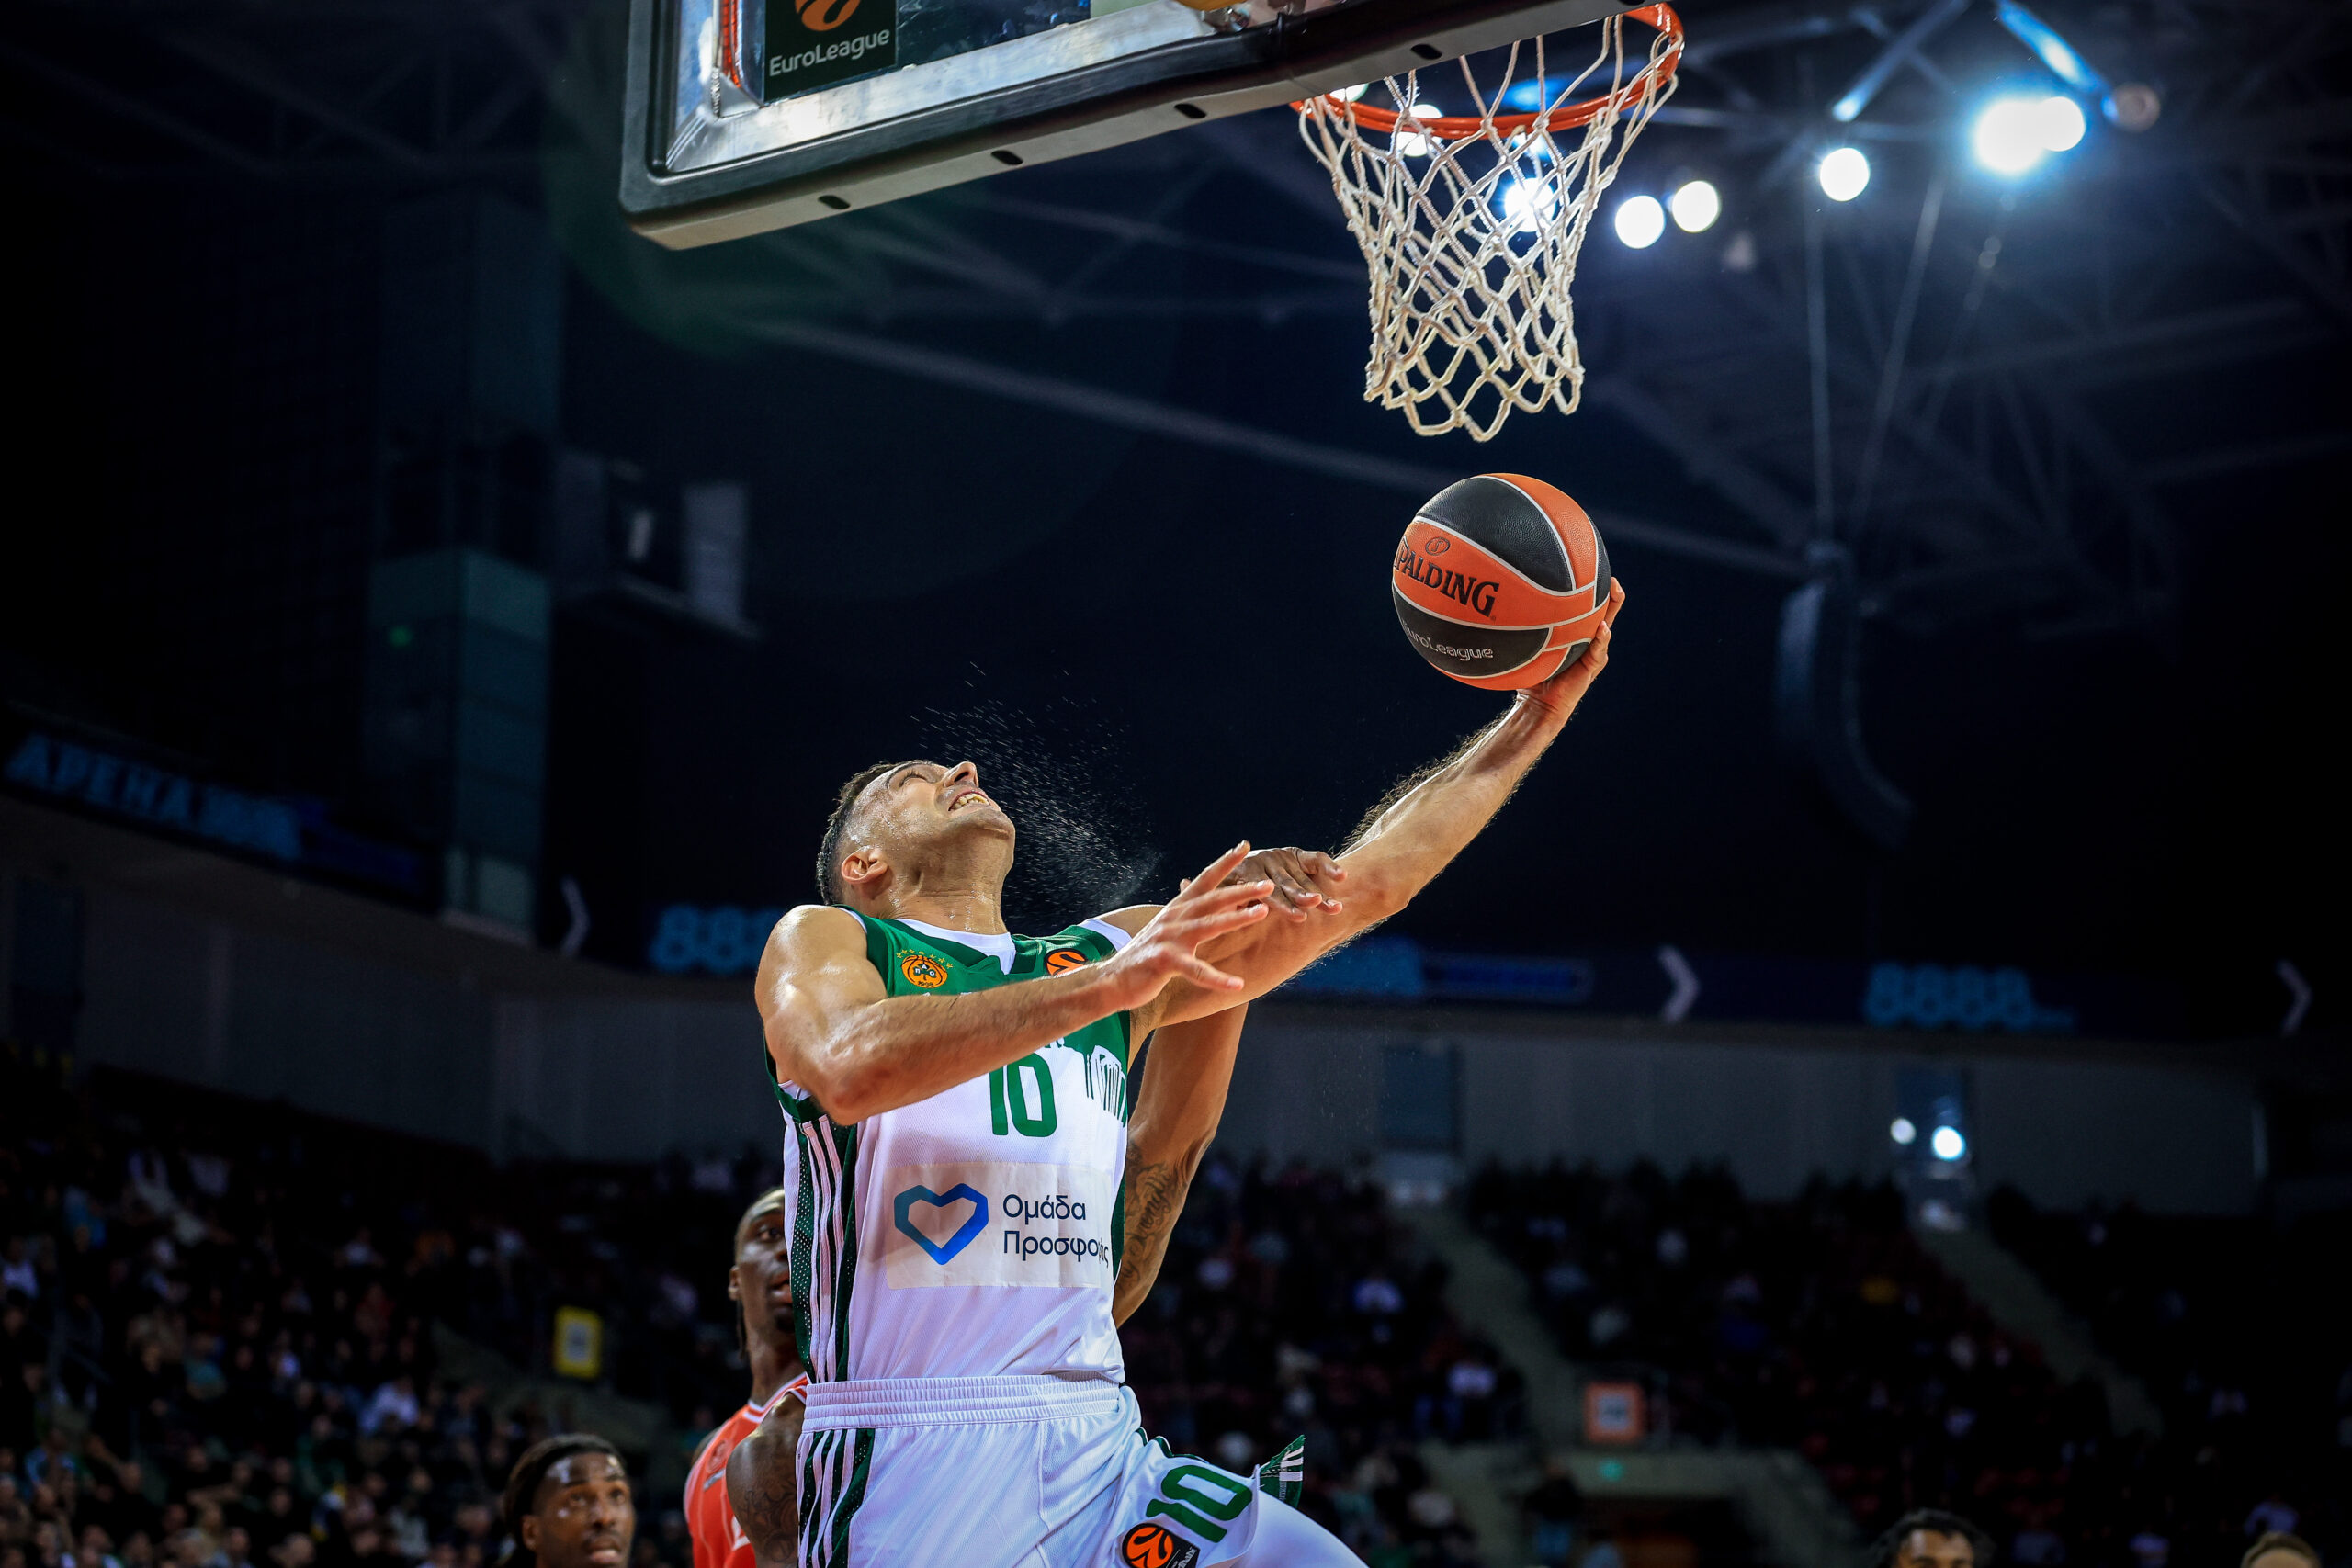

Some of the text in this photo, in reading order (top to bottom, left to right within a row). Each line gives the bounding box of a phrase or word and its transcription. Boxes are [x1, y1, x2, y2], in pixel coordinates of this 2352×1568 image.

[769, 28, 890, 77] EuroLeague
[989, 1052, 1057, 1138] 10
[1002, 1193, 1087, 1226] Ομάδα
[1145, 1464, 1253, 1544] 10
